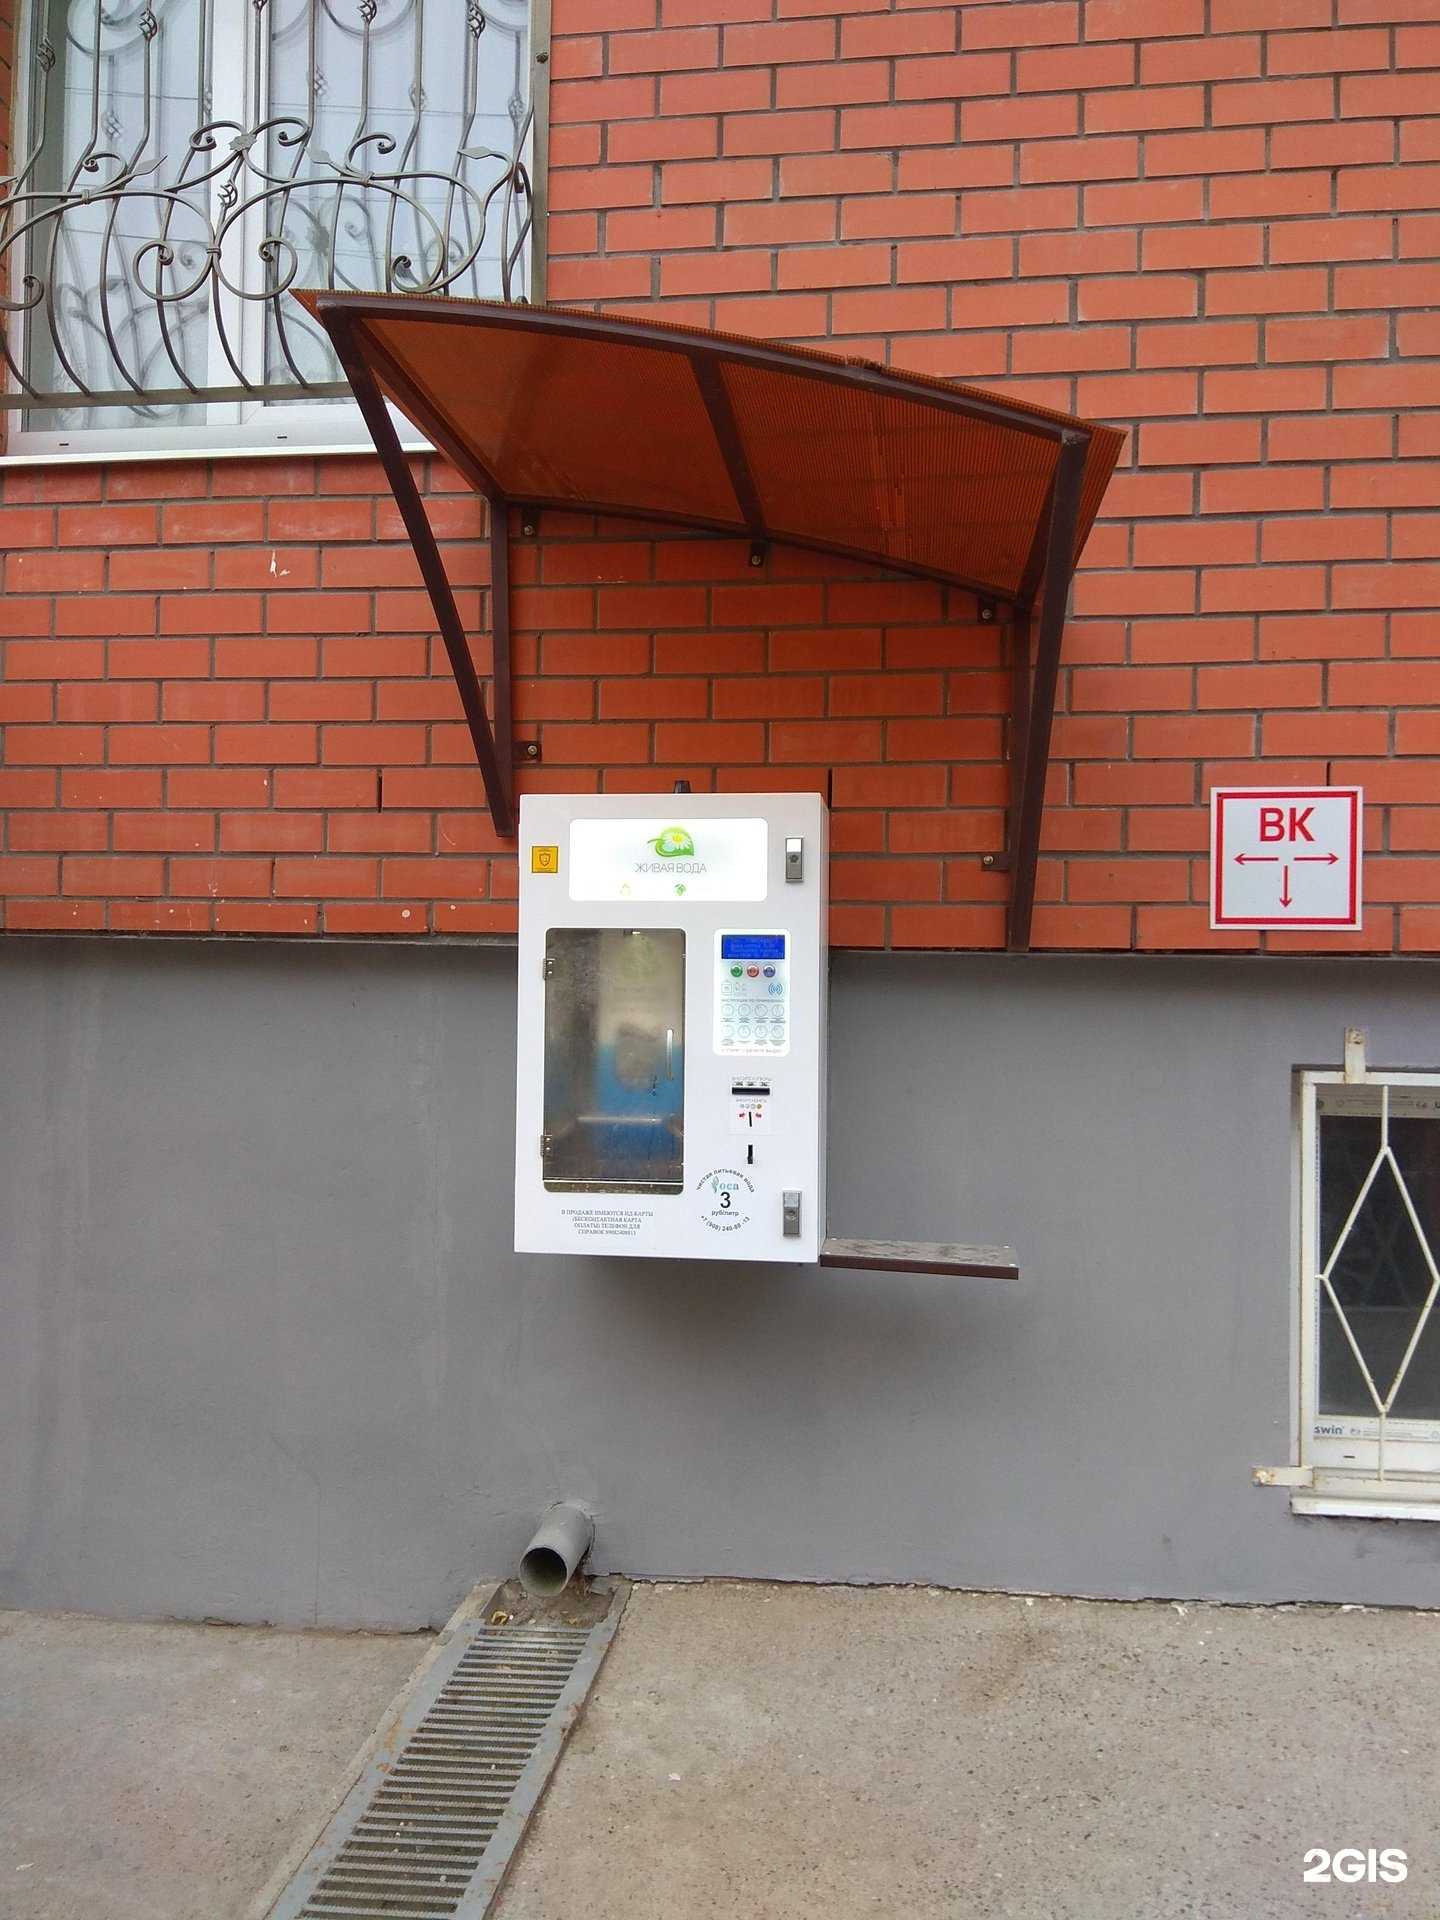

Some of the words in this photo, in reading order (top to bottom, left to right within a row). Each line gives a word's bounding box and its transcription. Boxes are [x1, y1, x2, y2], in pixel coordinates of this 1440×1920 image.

[1259, 807, 1316, 842] ВК
[633, 862, 674, 873] ЖИВАЯ
[676, 862, 707, 874] ВОДА
[720, 1191, 731, 1209] 3
